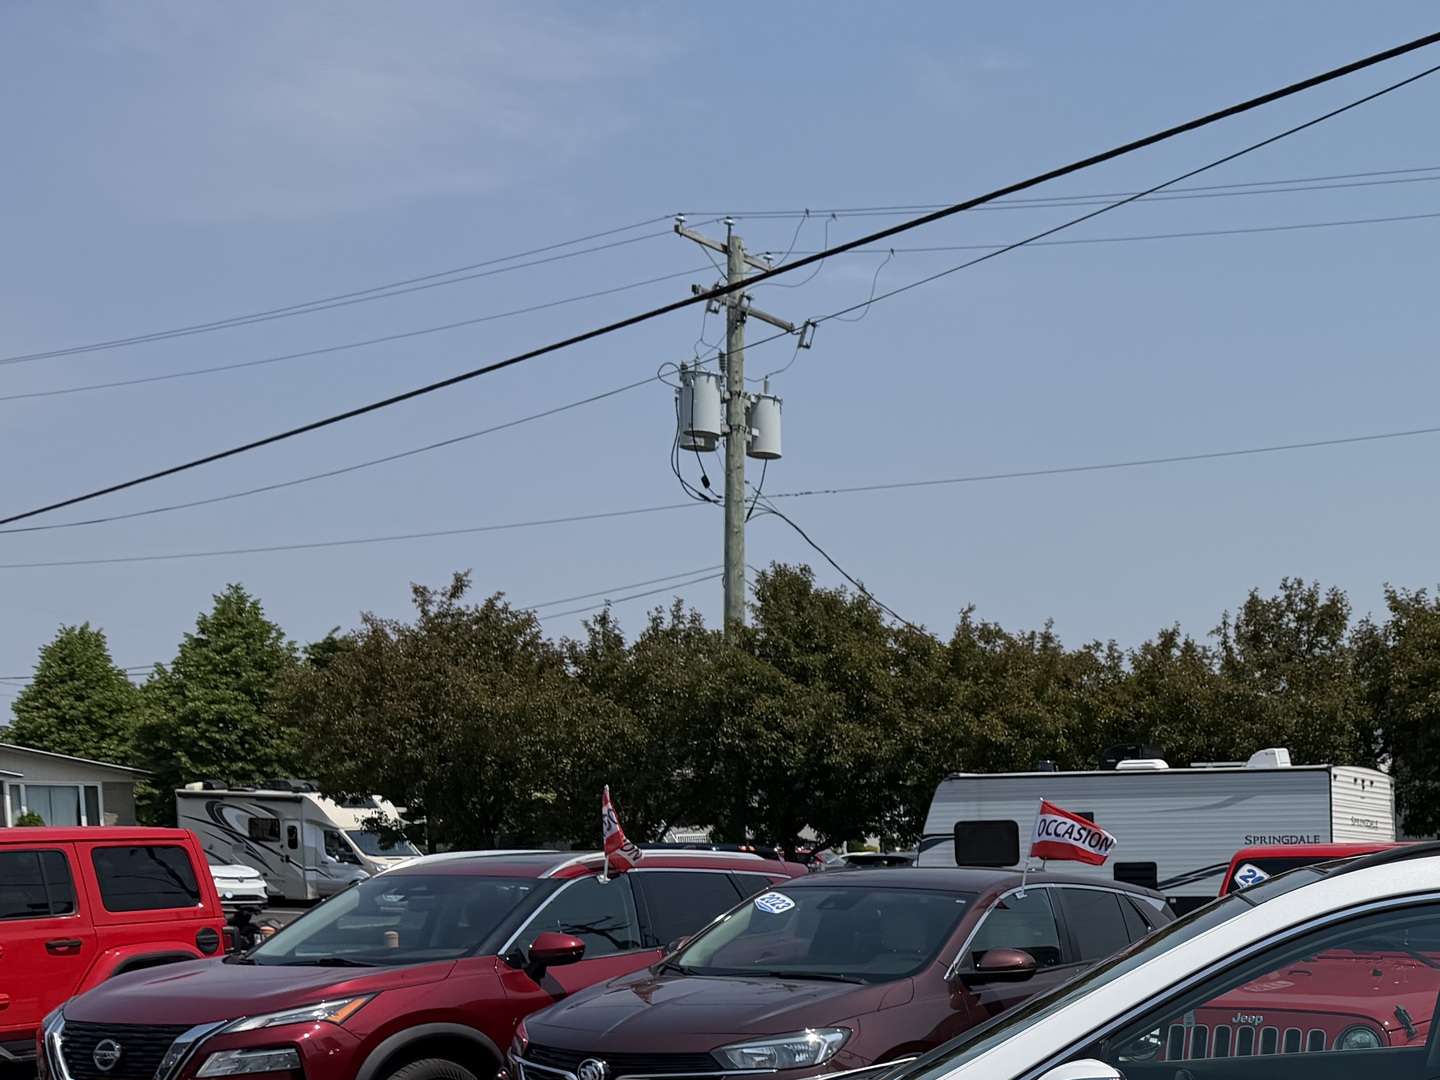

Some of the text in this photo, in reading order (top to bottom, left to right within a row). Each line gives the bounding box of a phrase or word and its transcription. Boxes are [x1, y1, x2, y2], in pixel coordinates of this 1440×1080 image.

[1037, 818, 1113, 851] OCCASION
[1244, 834, 1320, 845] SPRINGDALE
[1239, 868, 1265, 884] 20
[760, 894, 791, 910] 2023
[1232, 1012, 1264, 1026] Jeep
